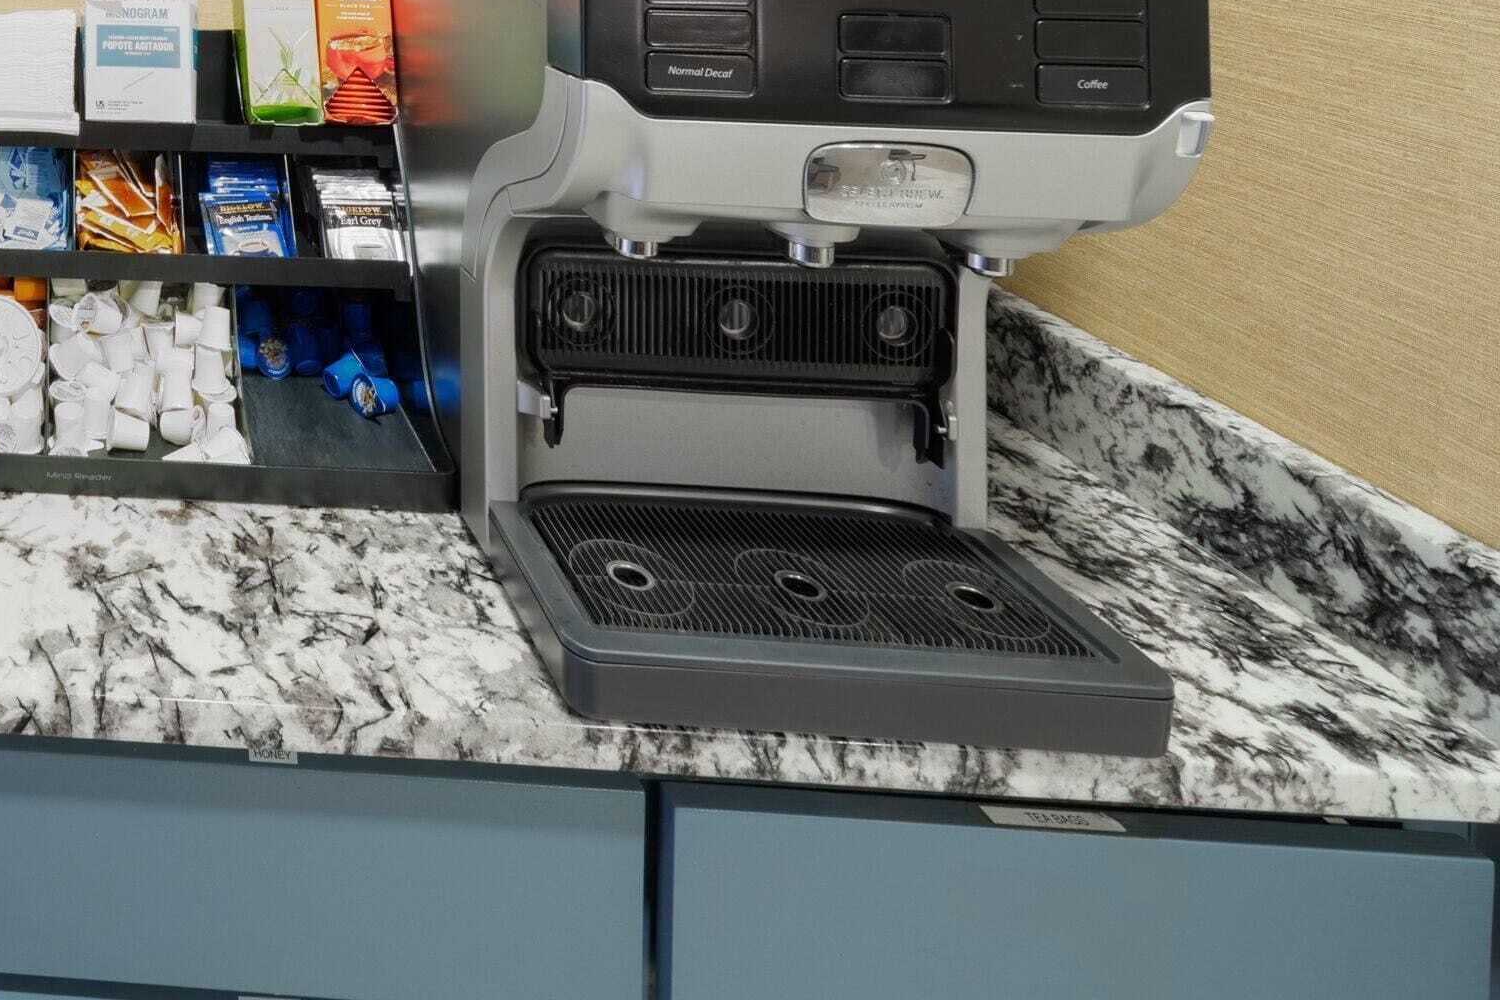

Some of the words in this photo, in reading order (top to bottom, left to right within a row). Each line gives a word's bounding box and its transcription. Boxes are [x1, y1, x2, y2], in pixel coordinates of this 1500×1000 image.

[102, 40, 133, 51] POPOTE
[134, 41, 175, 53] AGITADOR
[667, 65, 704, 77] Normal
[704, 67, 734, 79] Decaf
[1076, 79, 1109, 90] Coffee
[219, 214, 245, 226] English
[340, 215, 359, 225] Earl
[360, 215, 382, 228] Grey
[254, 749, 292, 760] HONEY
[1023, 812, 1055, 824] TEA
